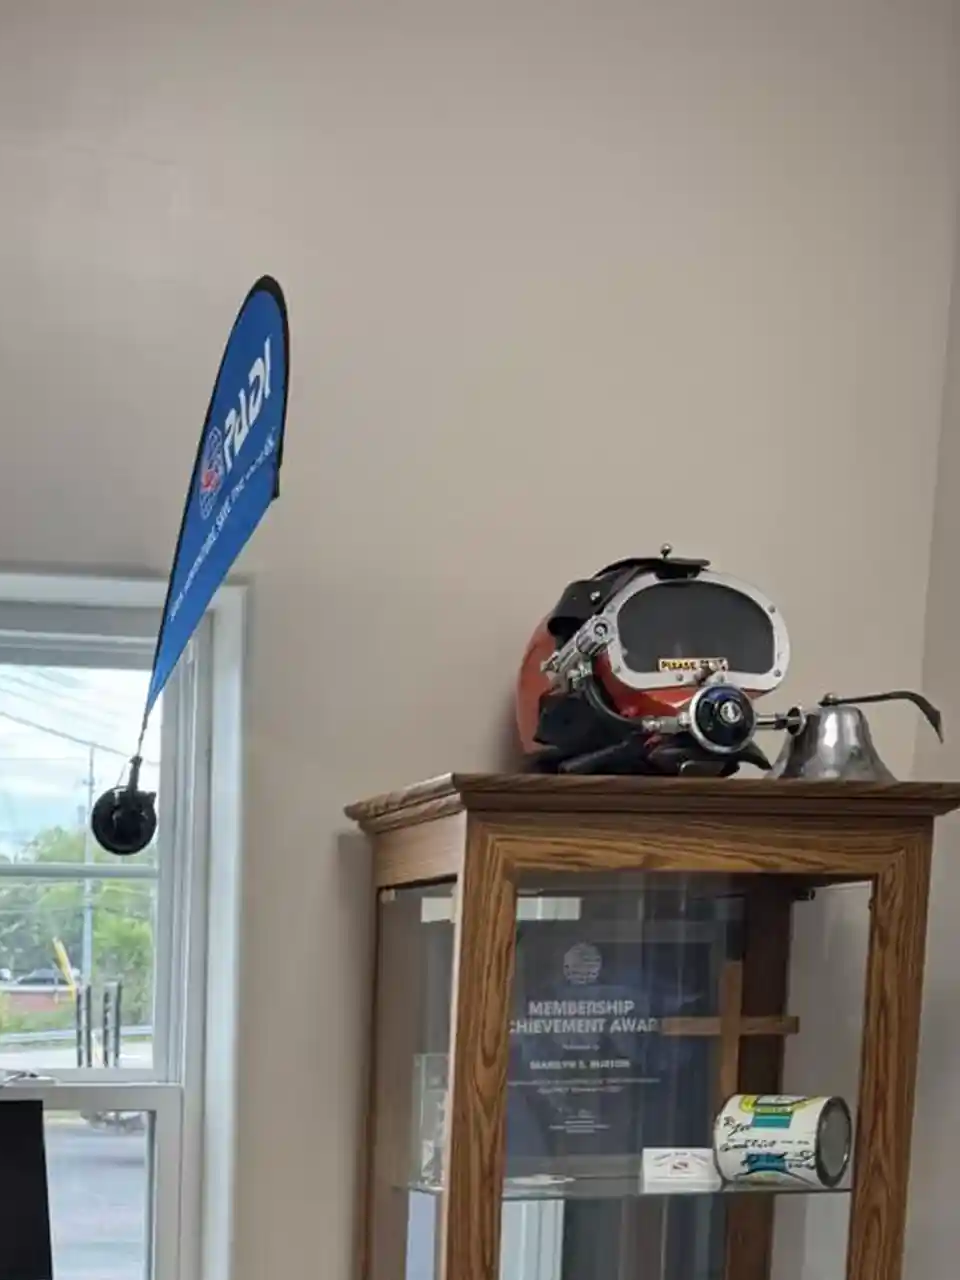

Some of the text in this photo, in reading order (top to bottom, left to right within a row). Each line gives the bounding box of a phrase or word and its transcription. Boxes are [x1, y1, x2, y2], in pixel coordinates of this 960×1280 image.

[528, 1000, 635, 1017] MEMBERSHIP
[509, 1017, 658, 1034] CHIEVEMENT AWAR
